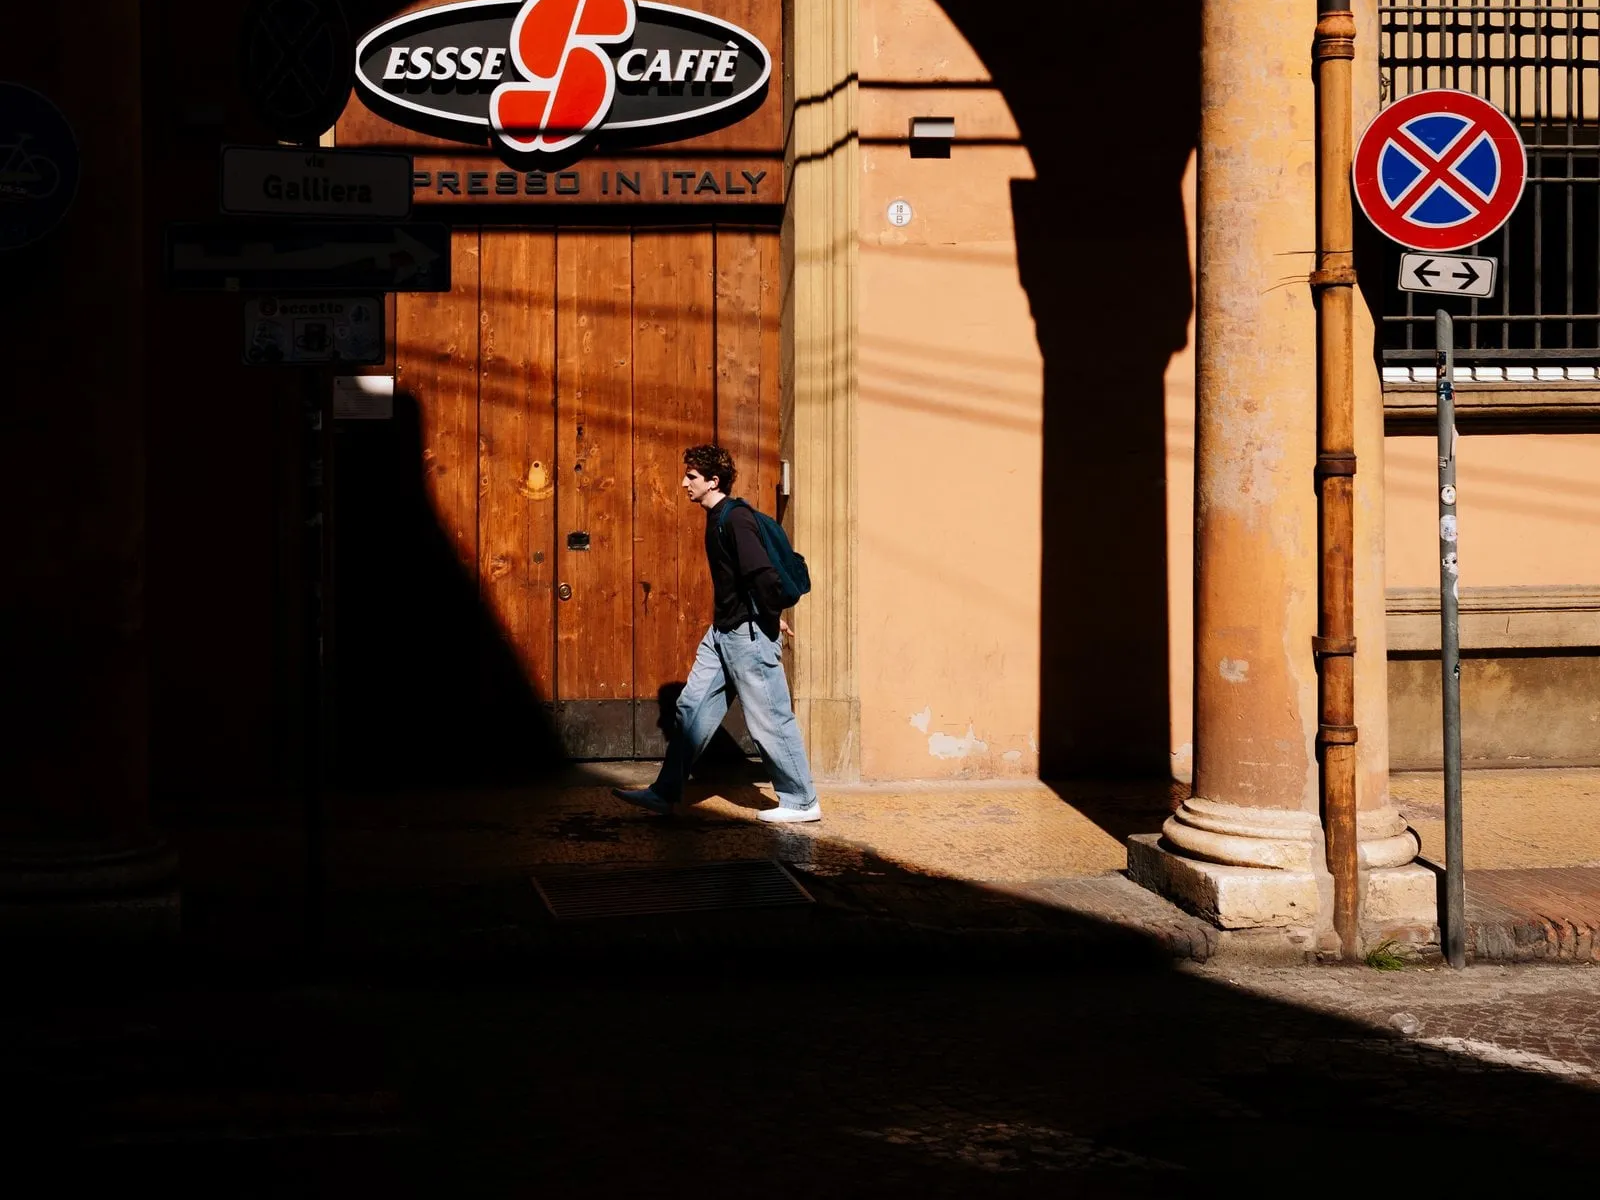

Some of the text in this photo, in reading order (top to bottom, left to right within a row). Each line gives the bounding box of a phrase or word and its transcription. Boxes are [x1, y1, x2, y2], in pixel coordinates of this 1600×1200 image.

[382, 40, 739, 83] ESSSE CAFFÈ
[262, 173, 373, 204] Galliera
[602, 171, 641, 195] IN
[662, 171, 767, 195] ITALY
